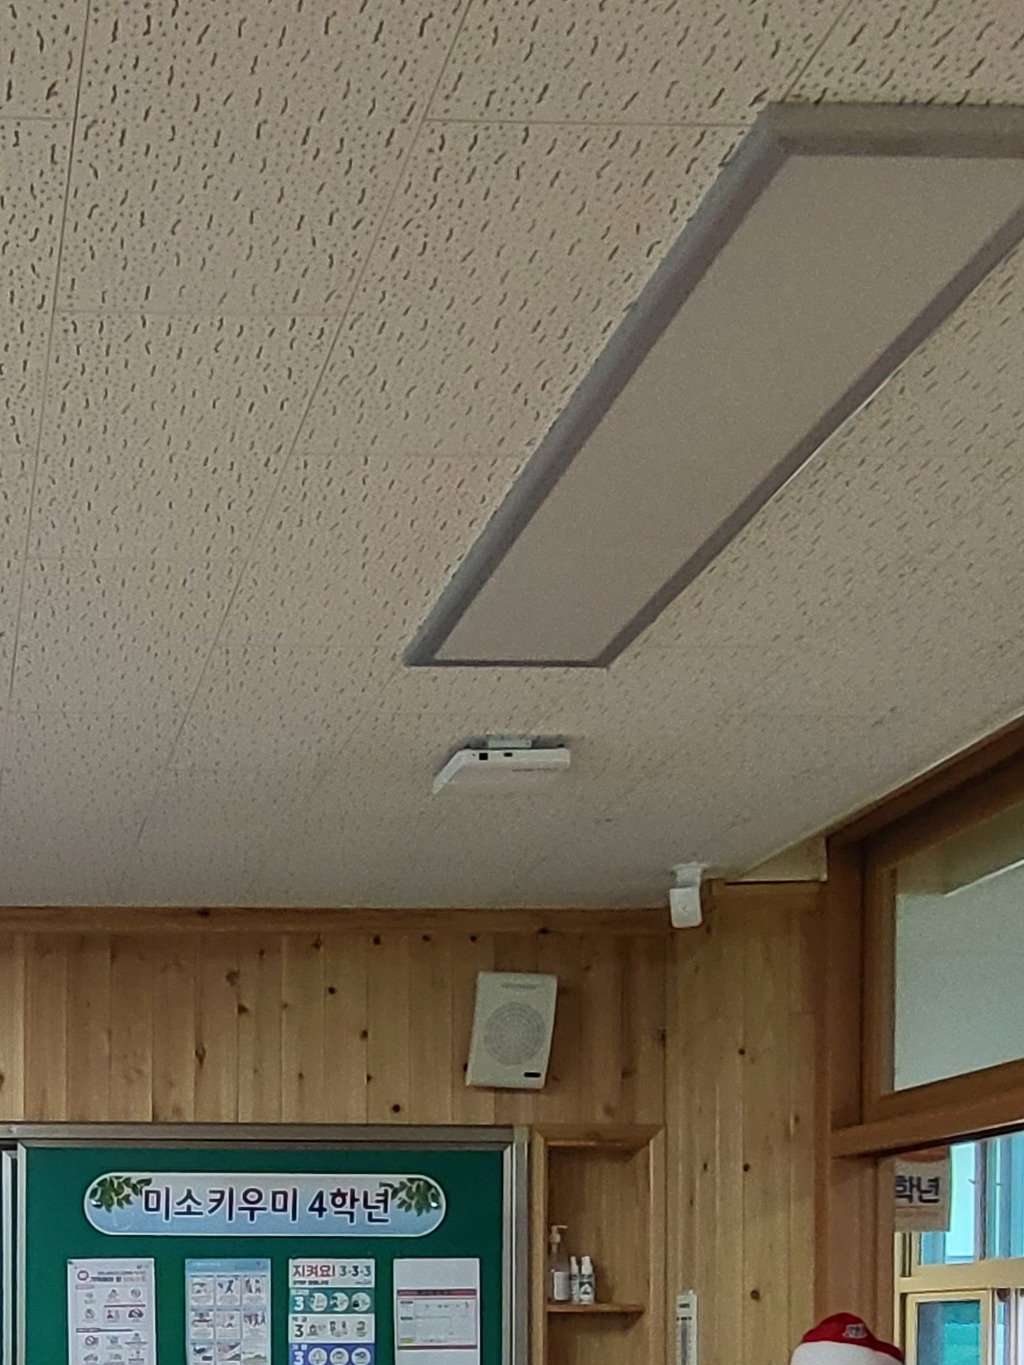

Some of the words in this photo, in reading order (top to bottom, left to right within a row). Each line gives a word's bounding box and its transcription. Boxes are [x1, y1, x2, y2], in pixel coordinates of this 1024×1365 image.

[143, 1187, 299, 1223] 미소키우미
[307, 1187, 391, 1224] 4학년
[293, 1296, 305, 1311] 3
[293, 1324, 305, 1338] 3
[293, 1351, 305, 1365] 3
